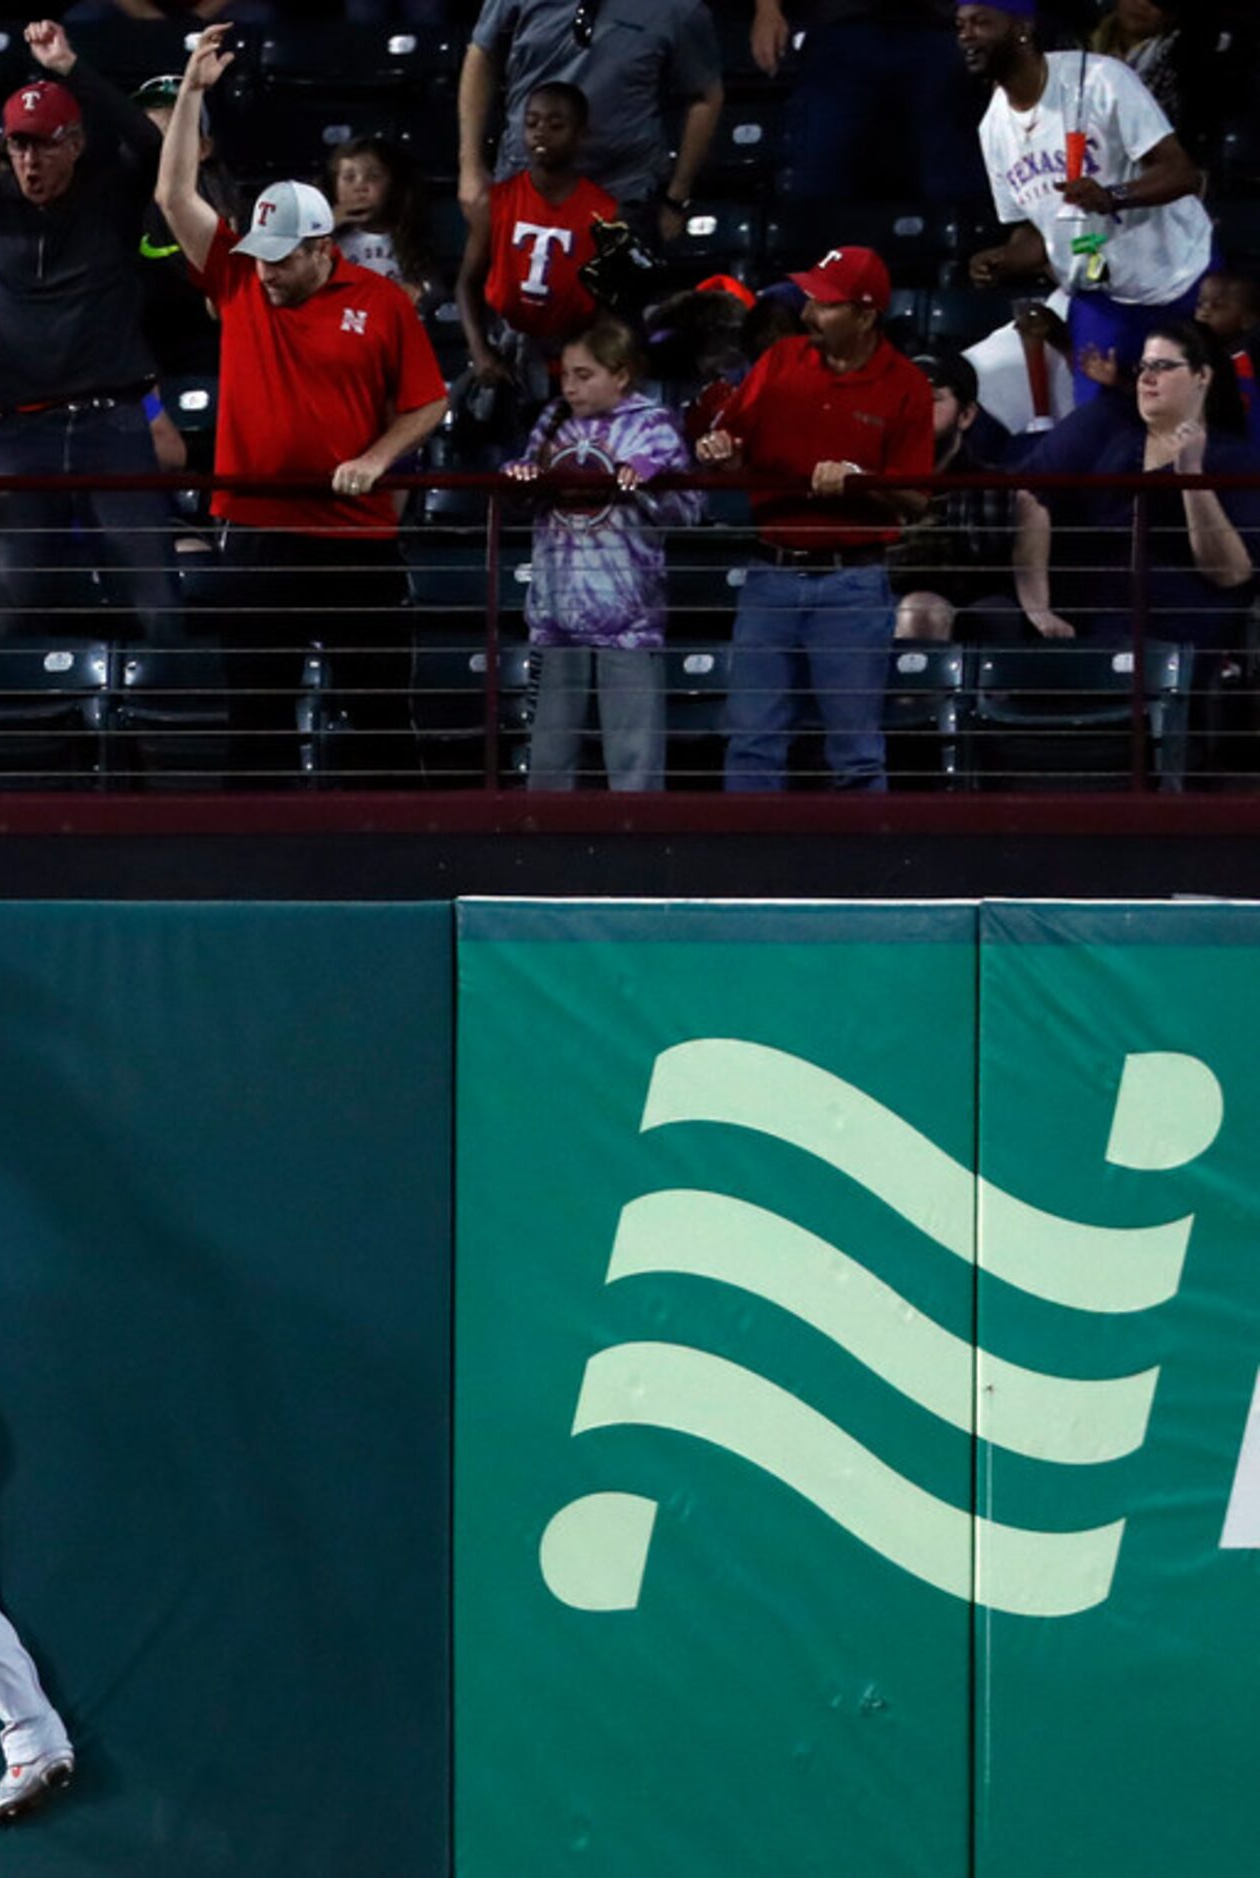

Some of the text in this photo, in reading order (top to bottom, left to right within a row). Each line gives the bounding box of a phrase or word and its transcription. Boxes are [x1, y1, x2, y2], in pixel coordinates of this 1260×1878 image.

[21, 91, 41, 110] T
[258, 201, 276, 226] T
[512, 221, 573, 296] T
[341, 308, 368, 335] N
